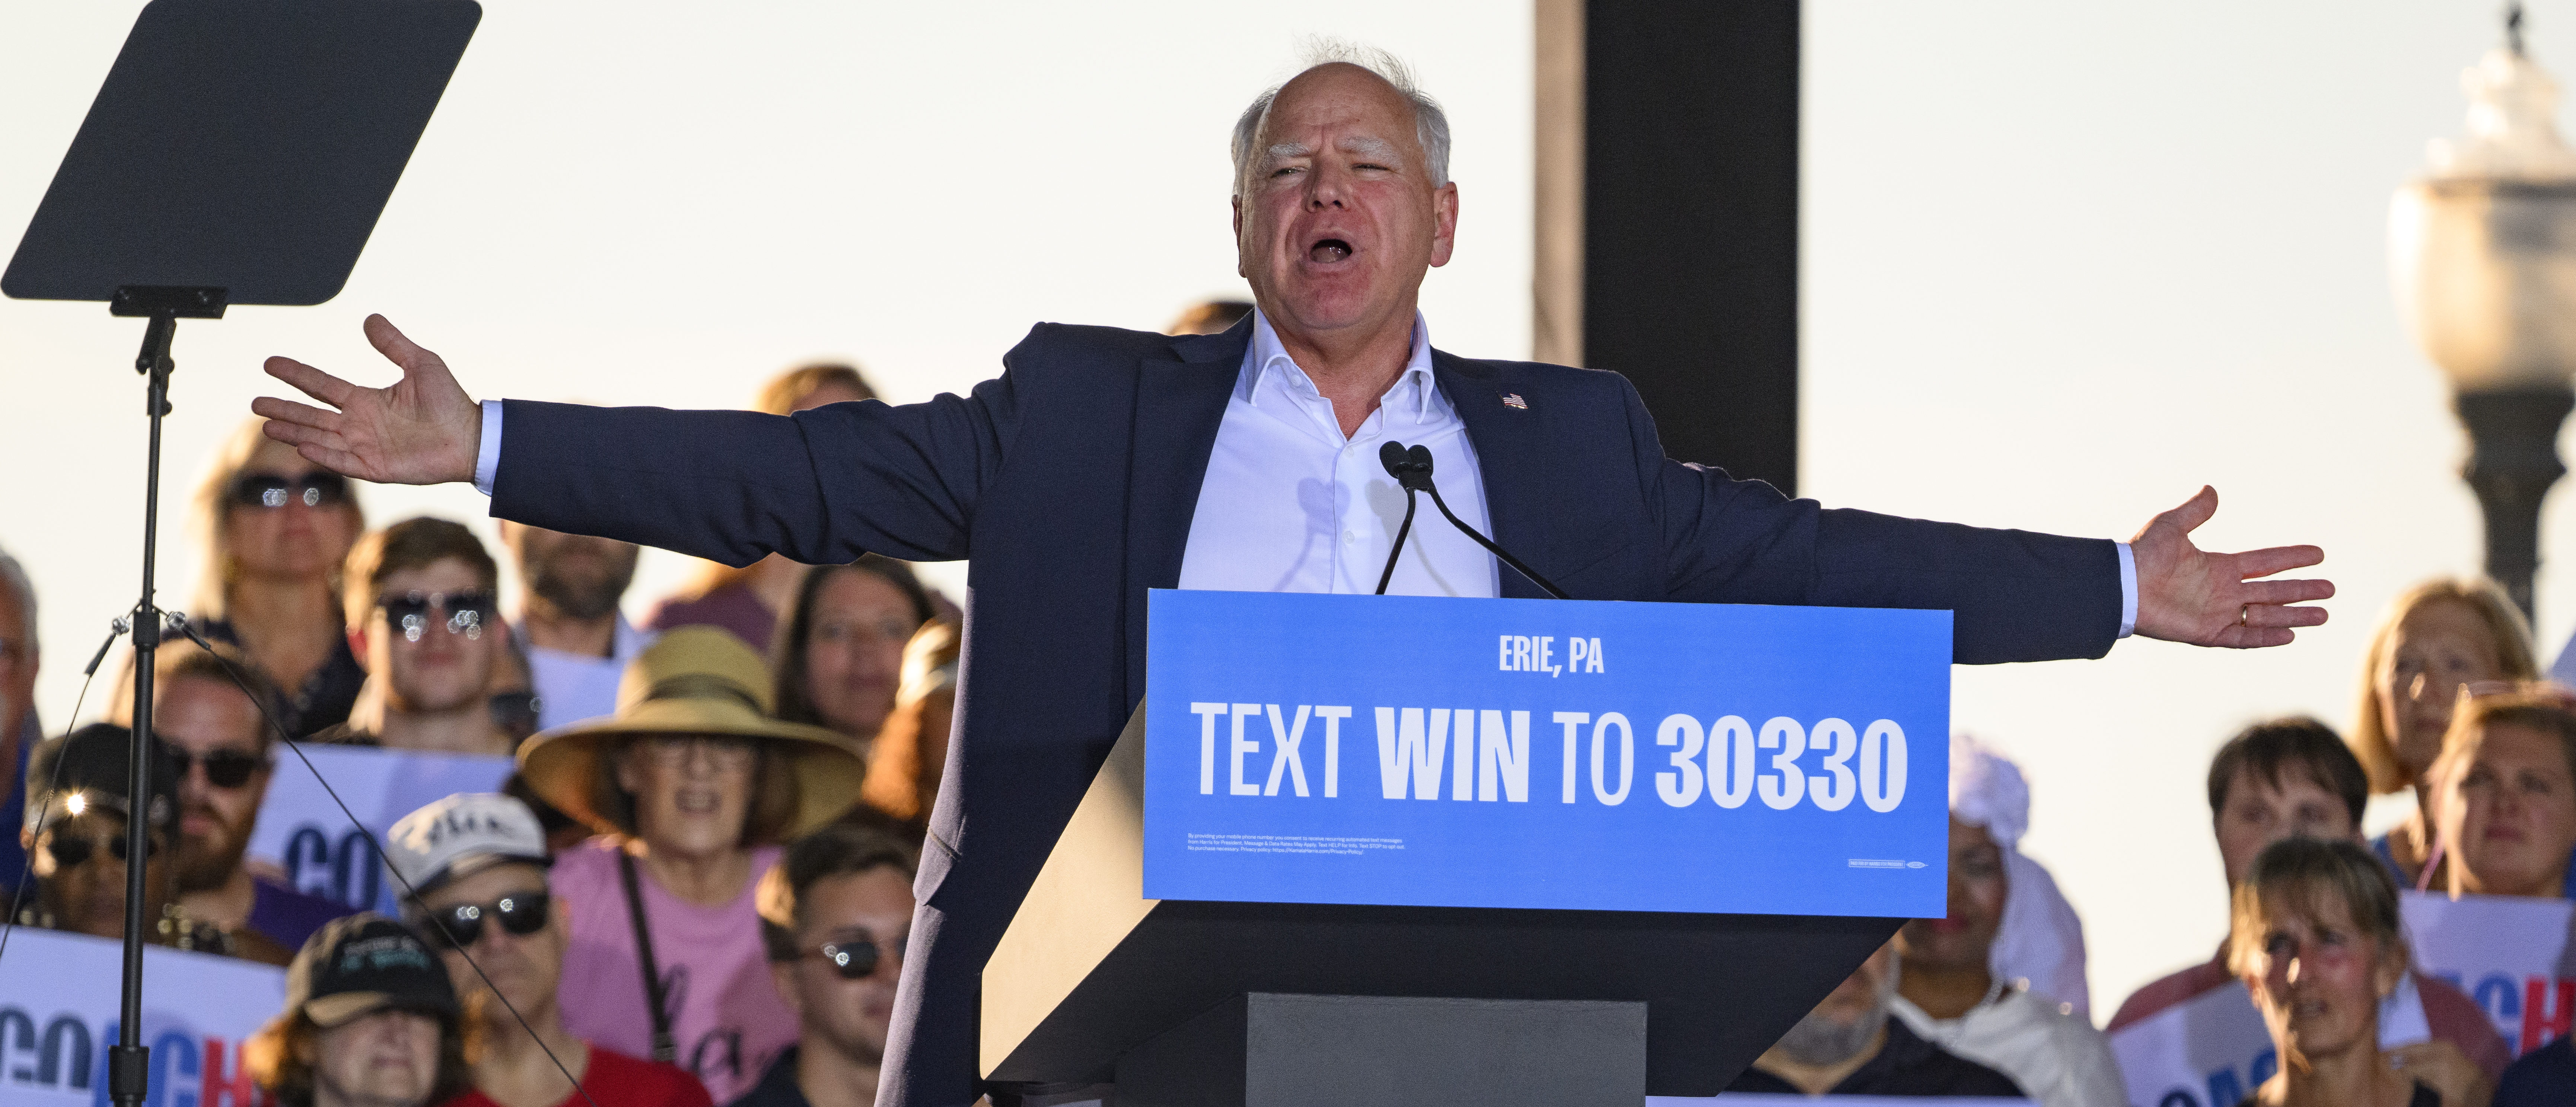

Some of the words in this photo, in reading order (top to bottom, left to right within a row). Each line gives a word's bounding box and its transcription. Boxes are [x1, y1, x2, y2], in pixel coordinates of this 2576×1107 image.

[1499, 635, 1562, 678] ERIE,
[1569, 637, 1604, 673] PA
[1191, 702, 1352, 798] TEXT
[1375, 706, 1530, 803] WIN
[1553, 711, 1634, 806] TO
[1655, 713, 1907, 813] 30330
